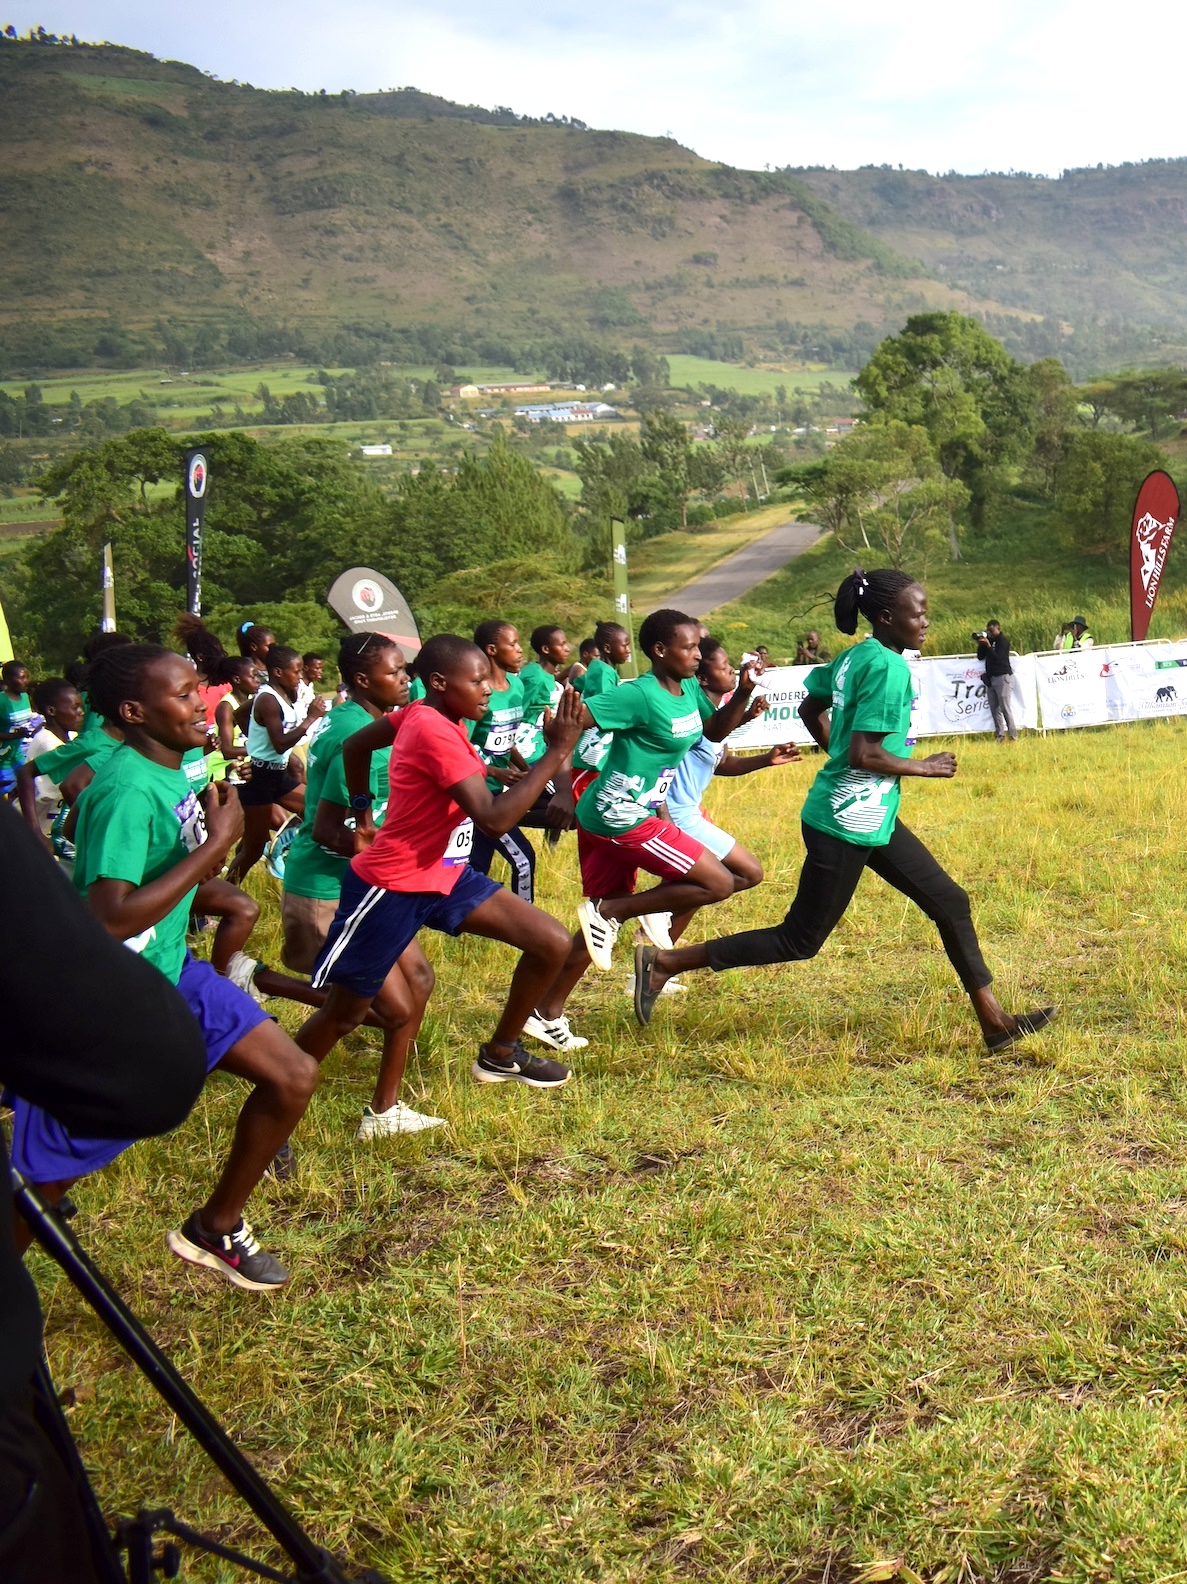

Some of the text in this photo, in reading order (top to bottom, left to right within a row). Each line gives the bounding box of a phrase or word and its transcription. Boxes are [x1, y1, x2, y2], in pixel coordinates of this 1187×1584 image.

[1145, 517, 1176, 608] LION HILLS FARM
